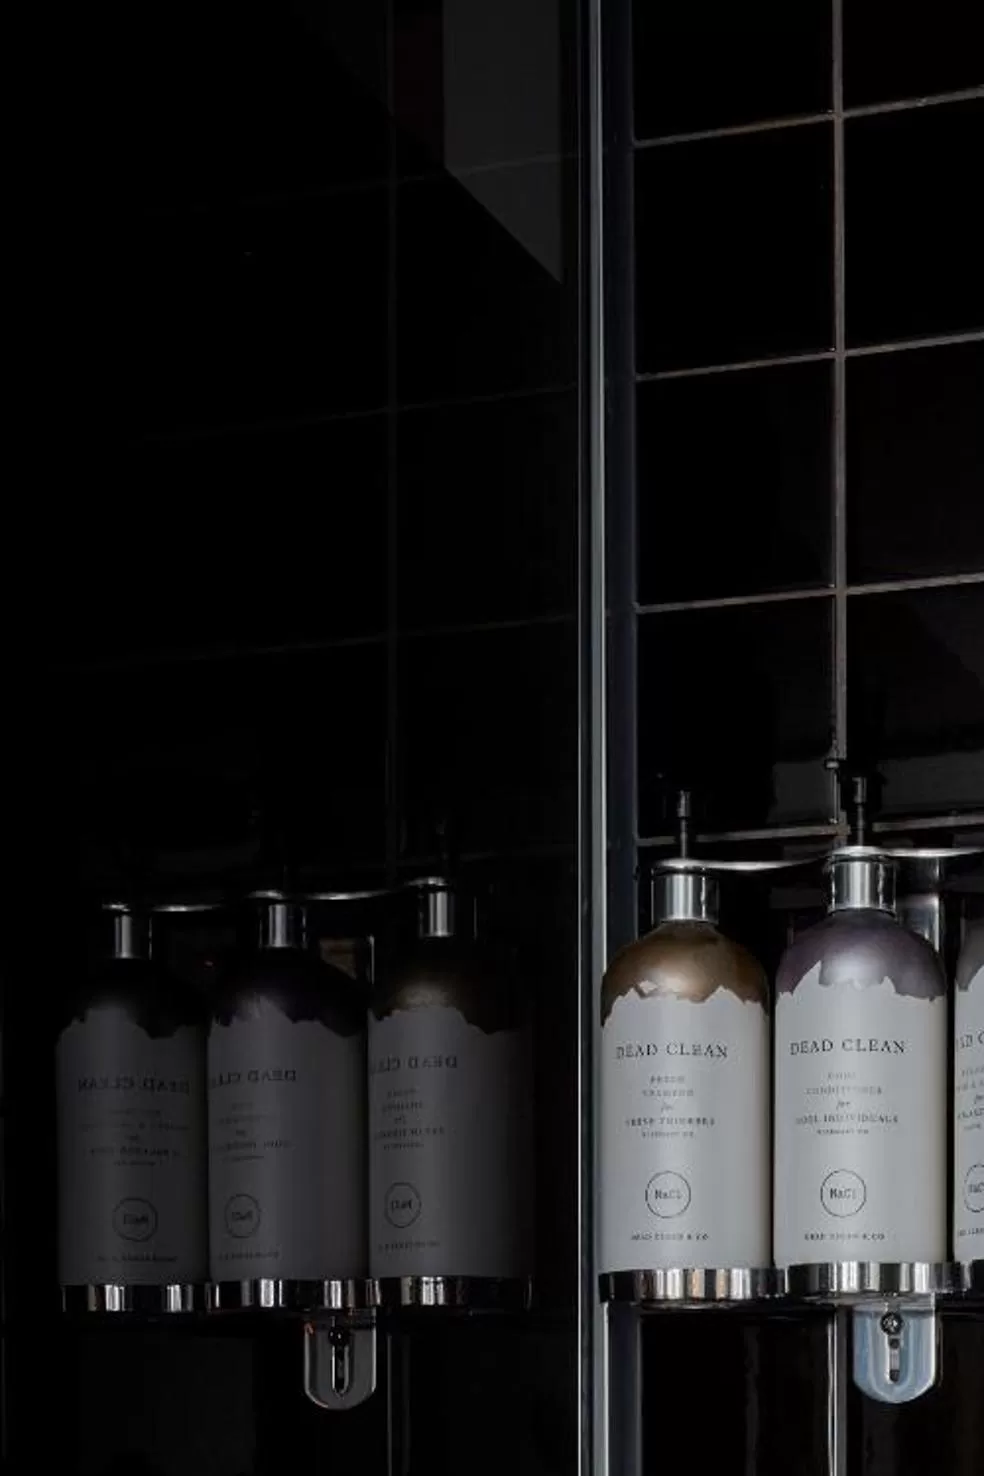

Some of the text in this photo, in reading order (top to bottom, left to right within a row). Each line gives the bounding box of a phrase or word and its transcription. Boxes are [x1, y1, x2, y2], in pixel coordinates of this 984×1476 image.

[615, 1042, 728, 1059] DEAD CLEAN
[790, 1038, 905, 1055] DEAD CLEAN
